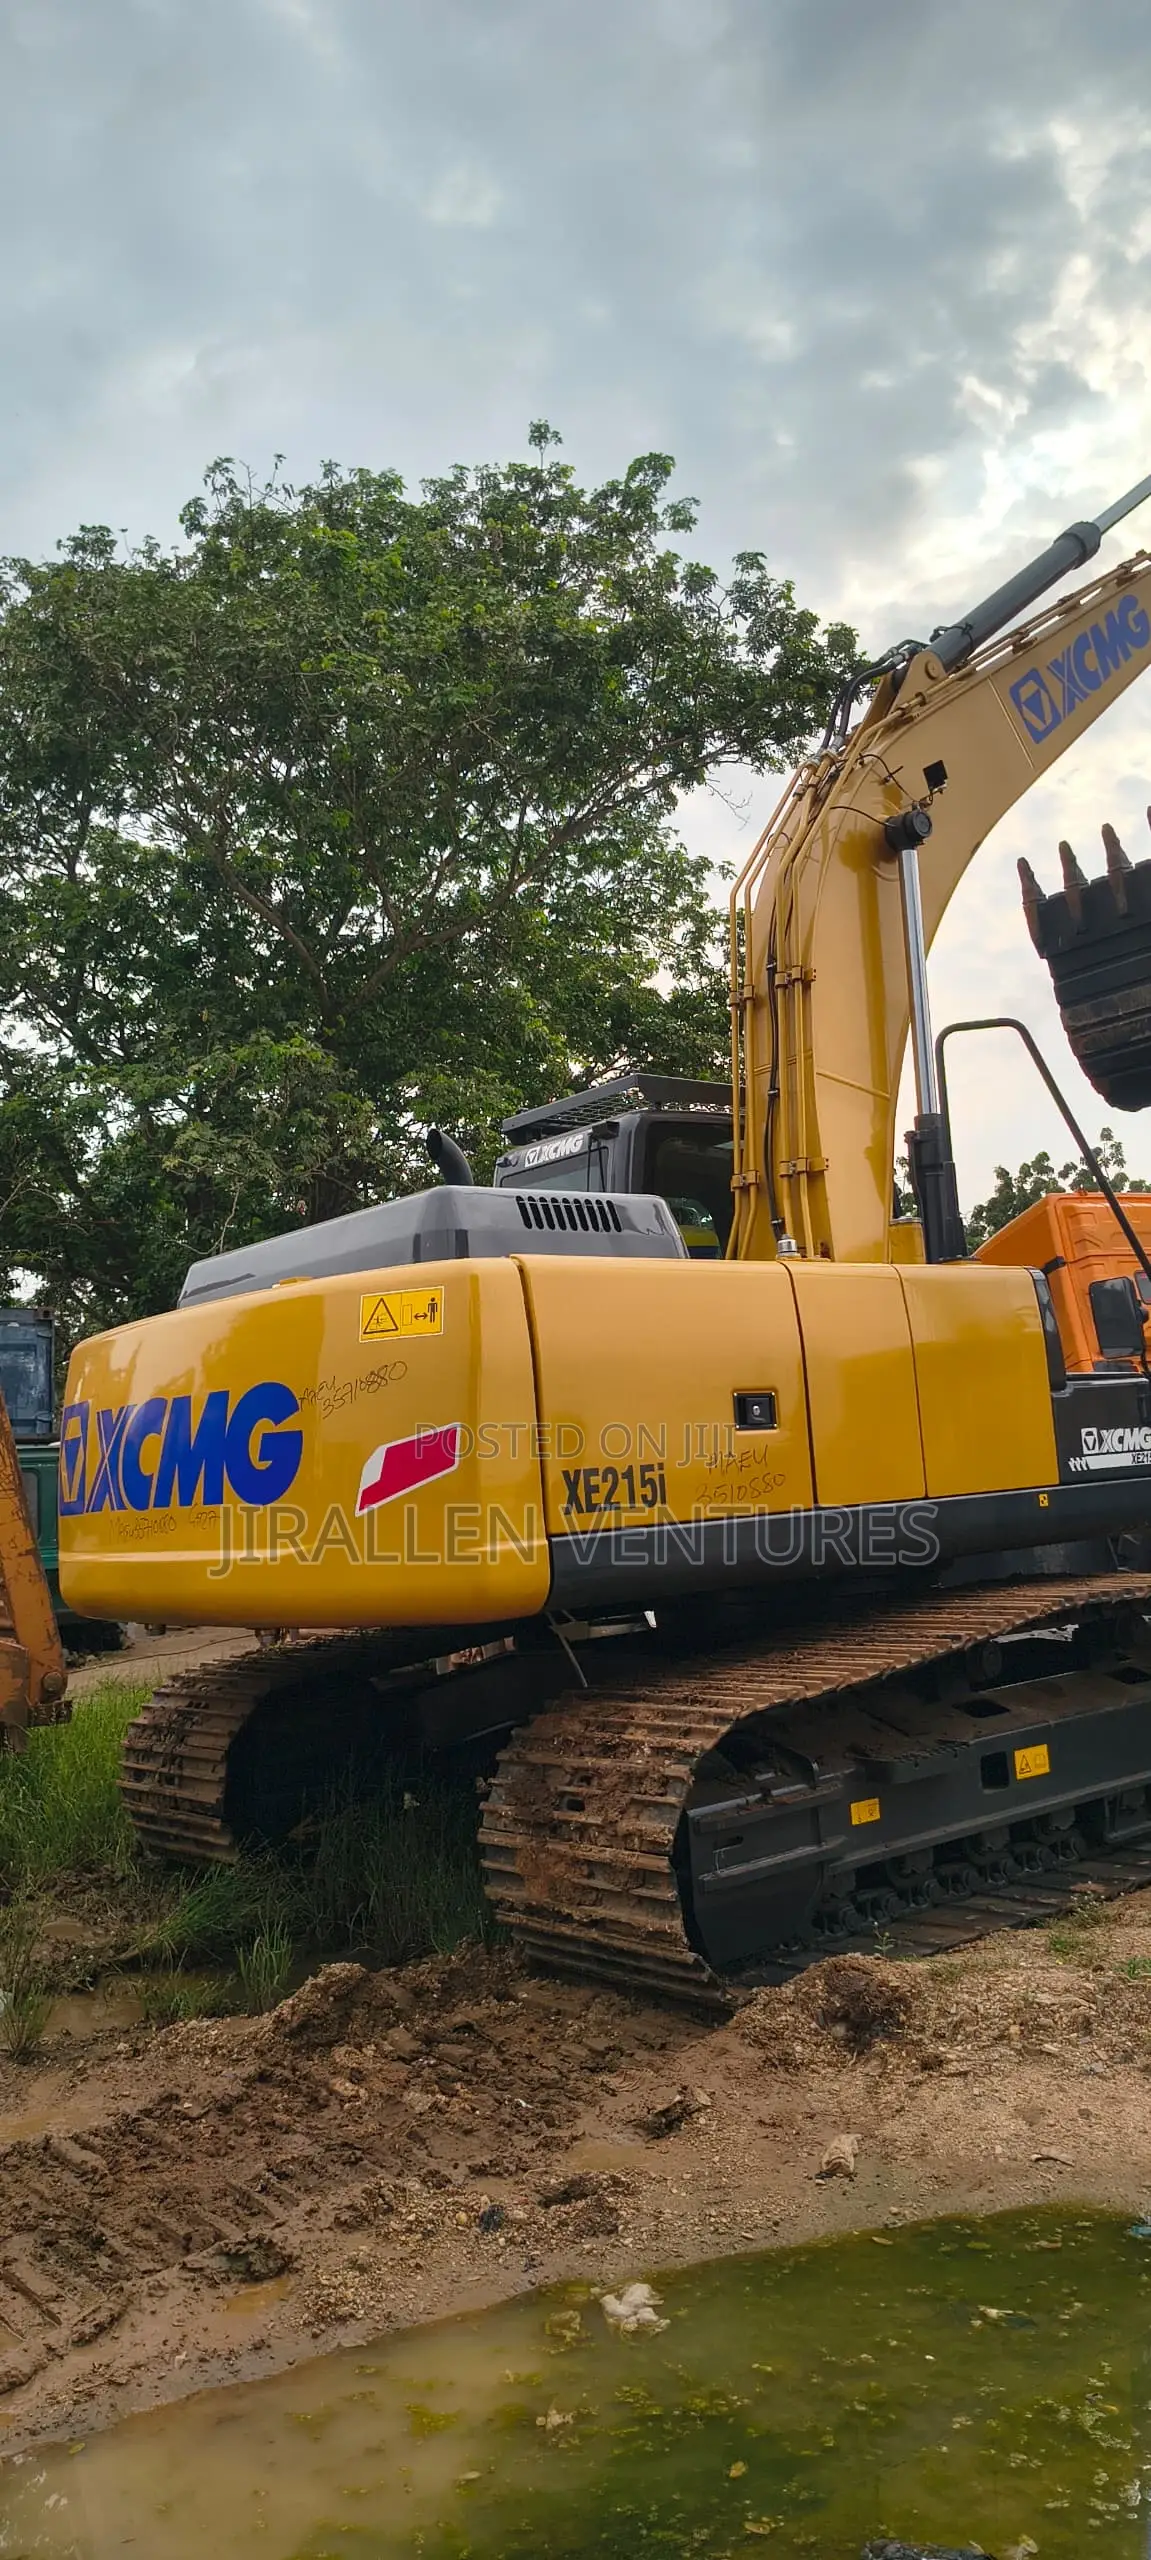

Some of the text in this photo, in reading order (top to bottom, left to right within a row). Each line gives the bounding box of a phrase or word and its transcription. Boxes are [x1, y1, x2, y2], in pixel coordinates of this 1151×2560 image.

[1046, 594, 1150, 721] XCMG
[538, 1134, 584, 1163] XCMG
[88, 1381, 303, 1512] XCMG
[1099, 1427, 1151, 1453] XCMG
[561, 1462, 666, 1515] XE215i
